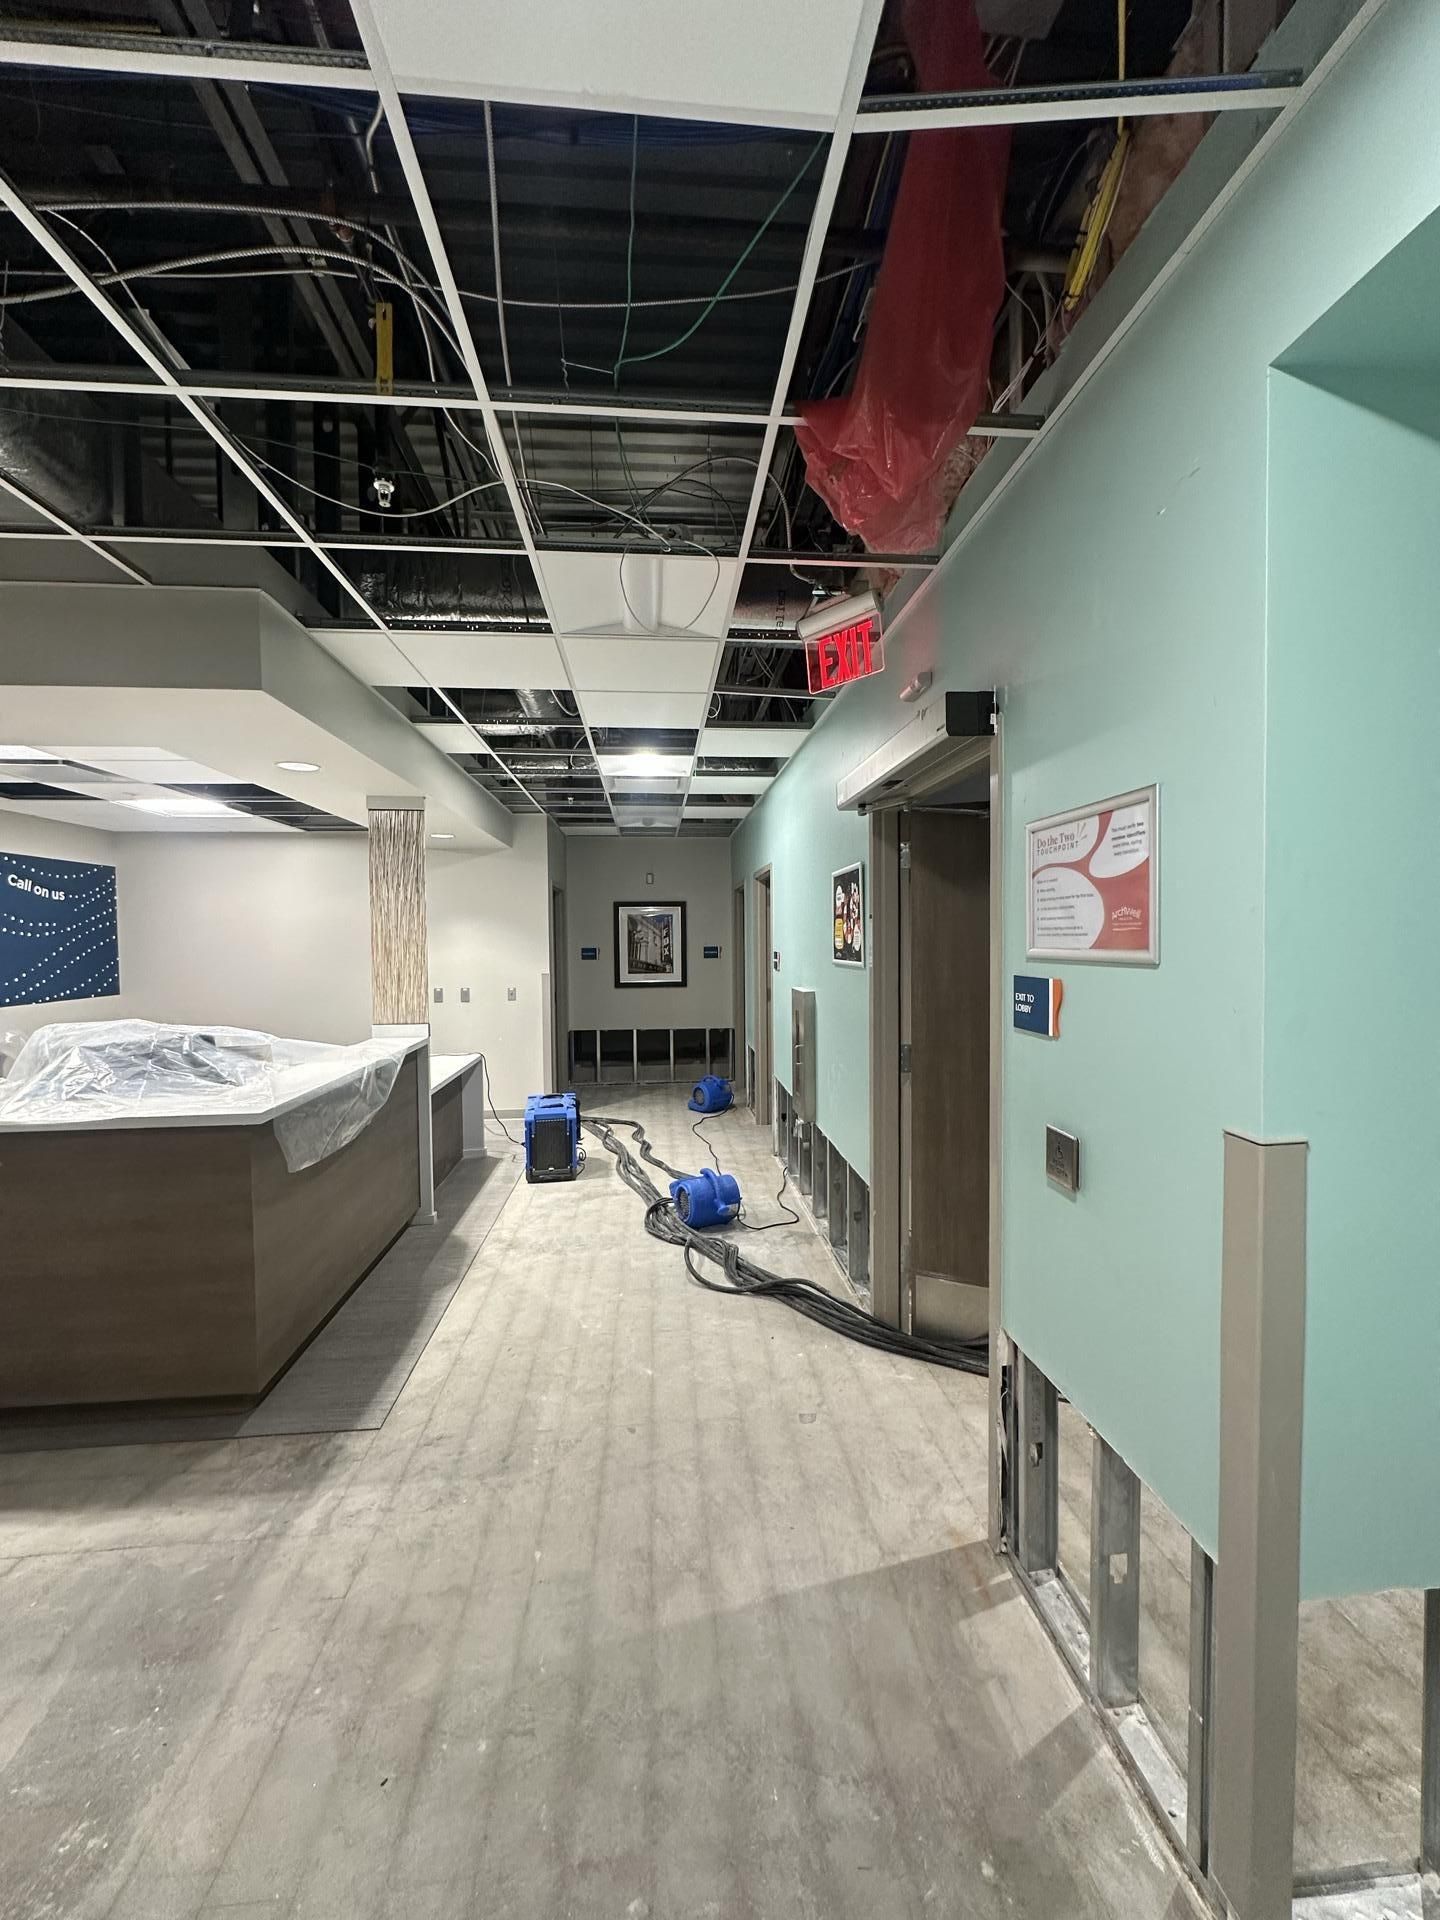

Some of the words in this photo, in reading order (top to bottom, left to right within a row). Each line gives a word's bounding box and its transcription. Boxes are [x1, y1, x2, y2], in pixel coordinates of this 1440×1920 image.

[817, 619, 873, 688] EXIT
[1037, 838, 1046, 849] Do
[1047, 835, 1058, 846] the
[1059, 832, 1075, 843] Two
[1037, 840, 1079, 856] TOUCHPOINT
[8, 874, 32, 892] Call
[33, 886, 49, 898] on
[51, 889, 66, 901] us
[1015, 992, 1026, 1002] EXIT
[1027, 994, 1035, 1003] TO
[1015, 1003, 1032, 1014] LOBBY
